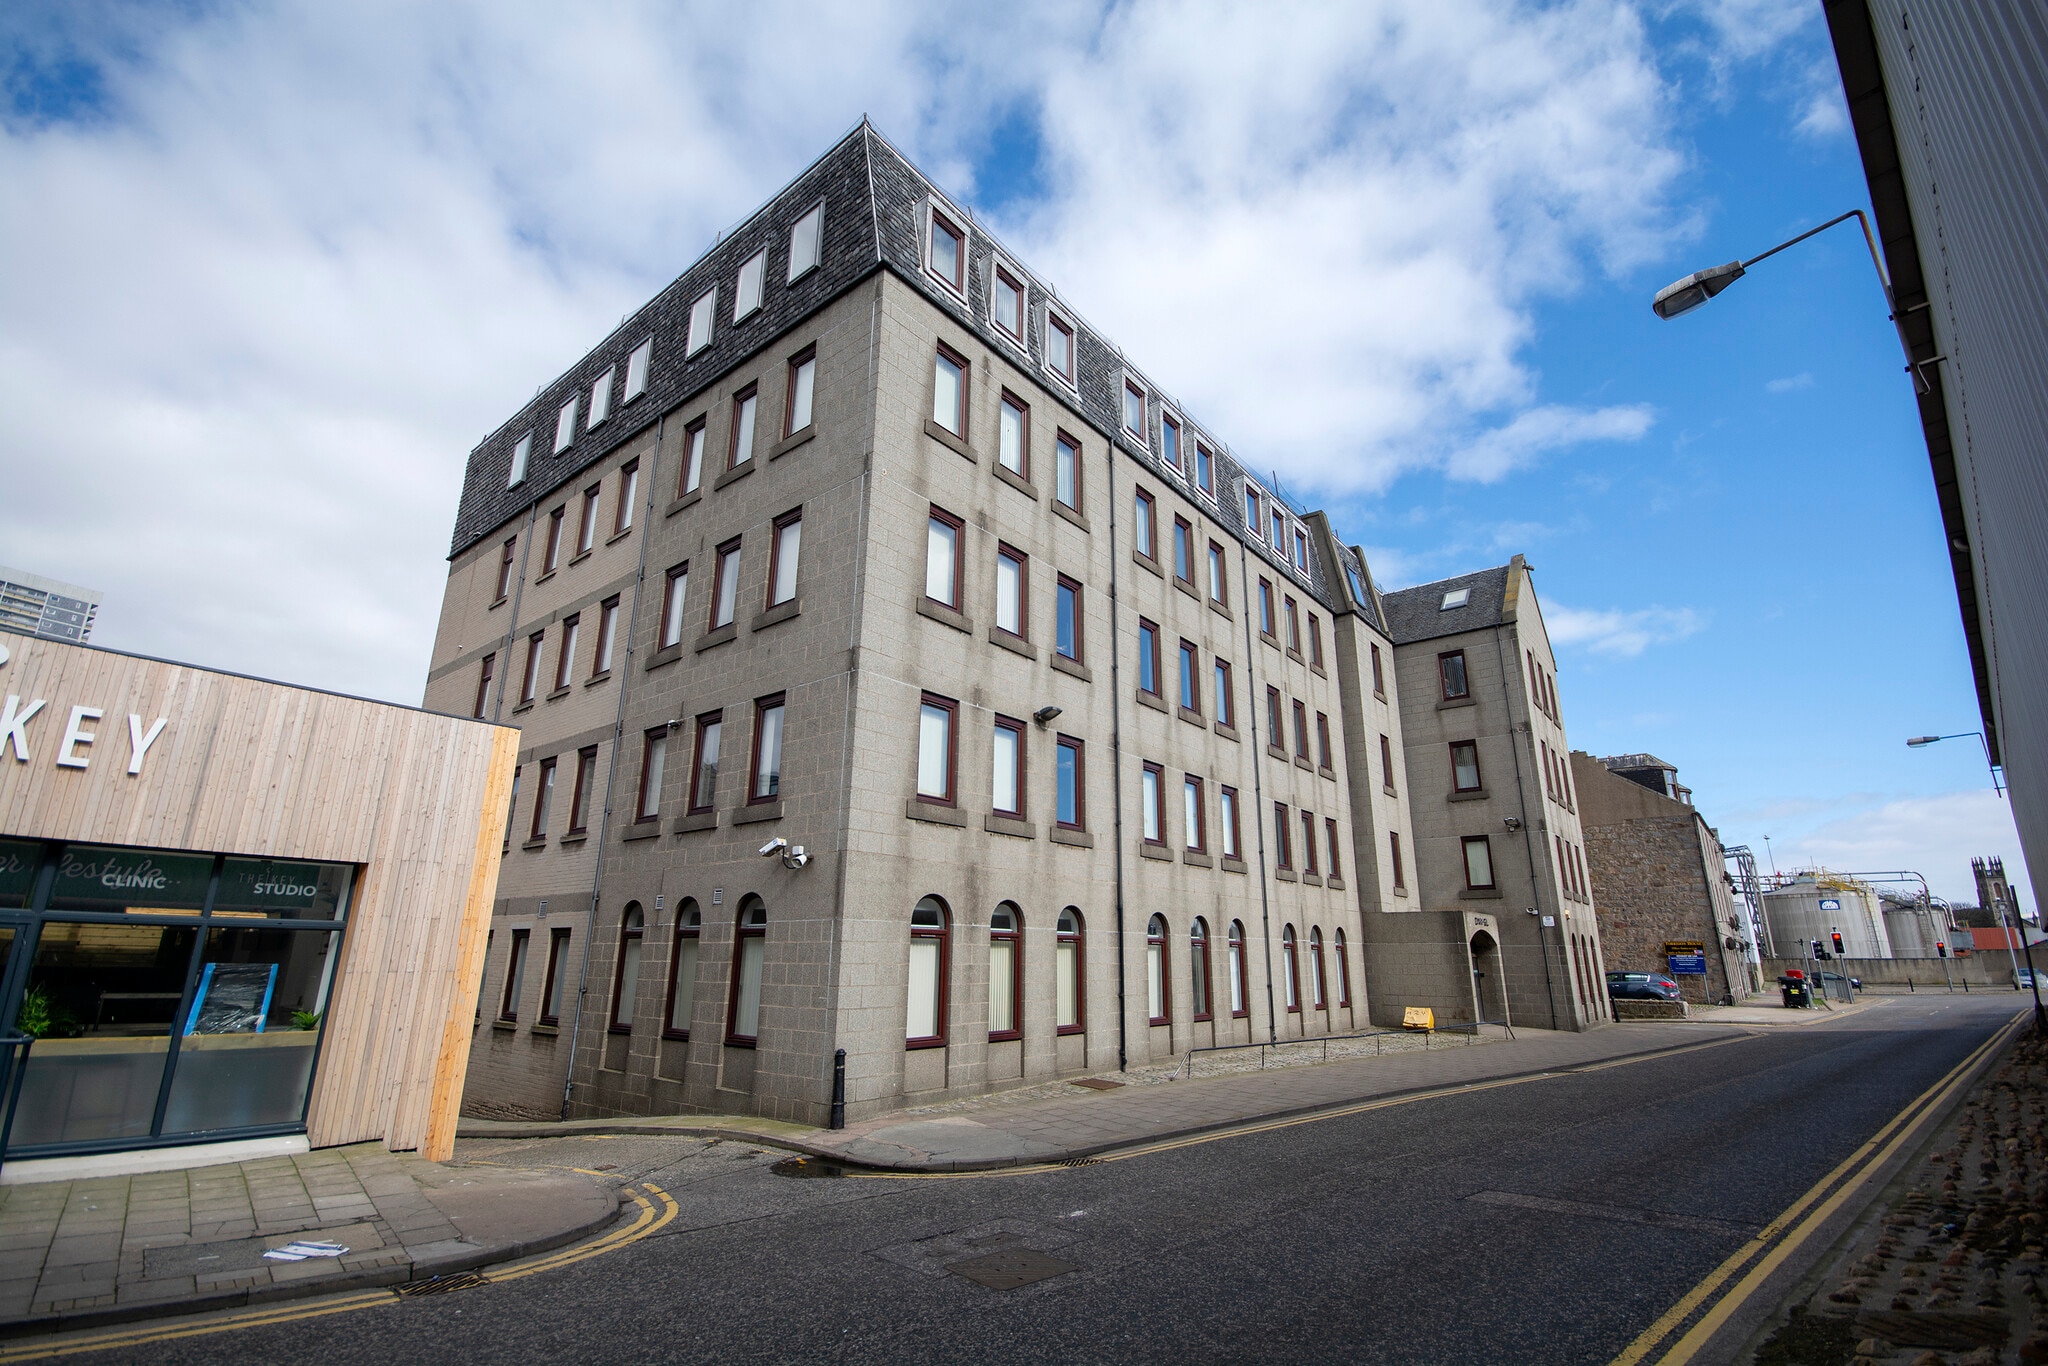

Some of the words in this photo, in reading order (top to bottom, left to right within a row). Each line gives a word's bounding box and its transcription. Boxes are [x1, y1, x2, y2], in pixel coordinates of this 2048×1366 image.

[0, 694, 169, 775] KEY
[102, 873, 168, 889] CLINIC
[253, 882, 317, 897] STUDIO
